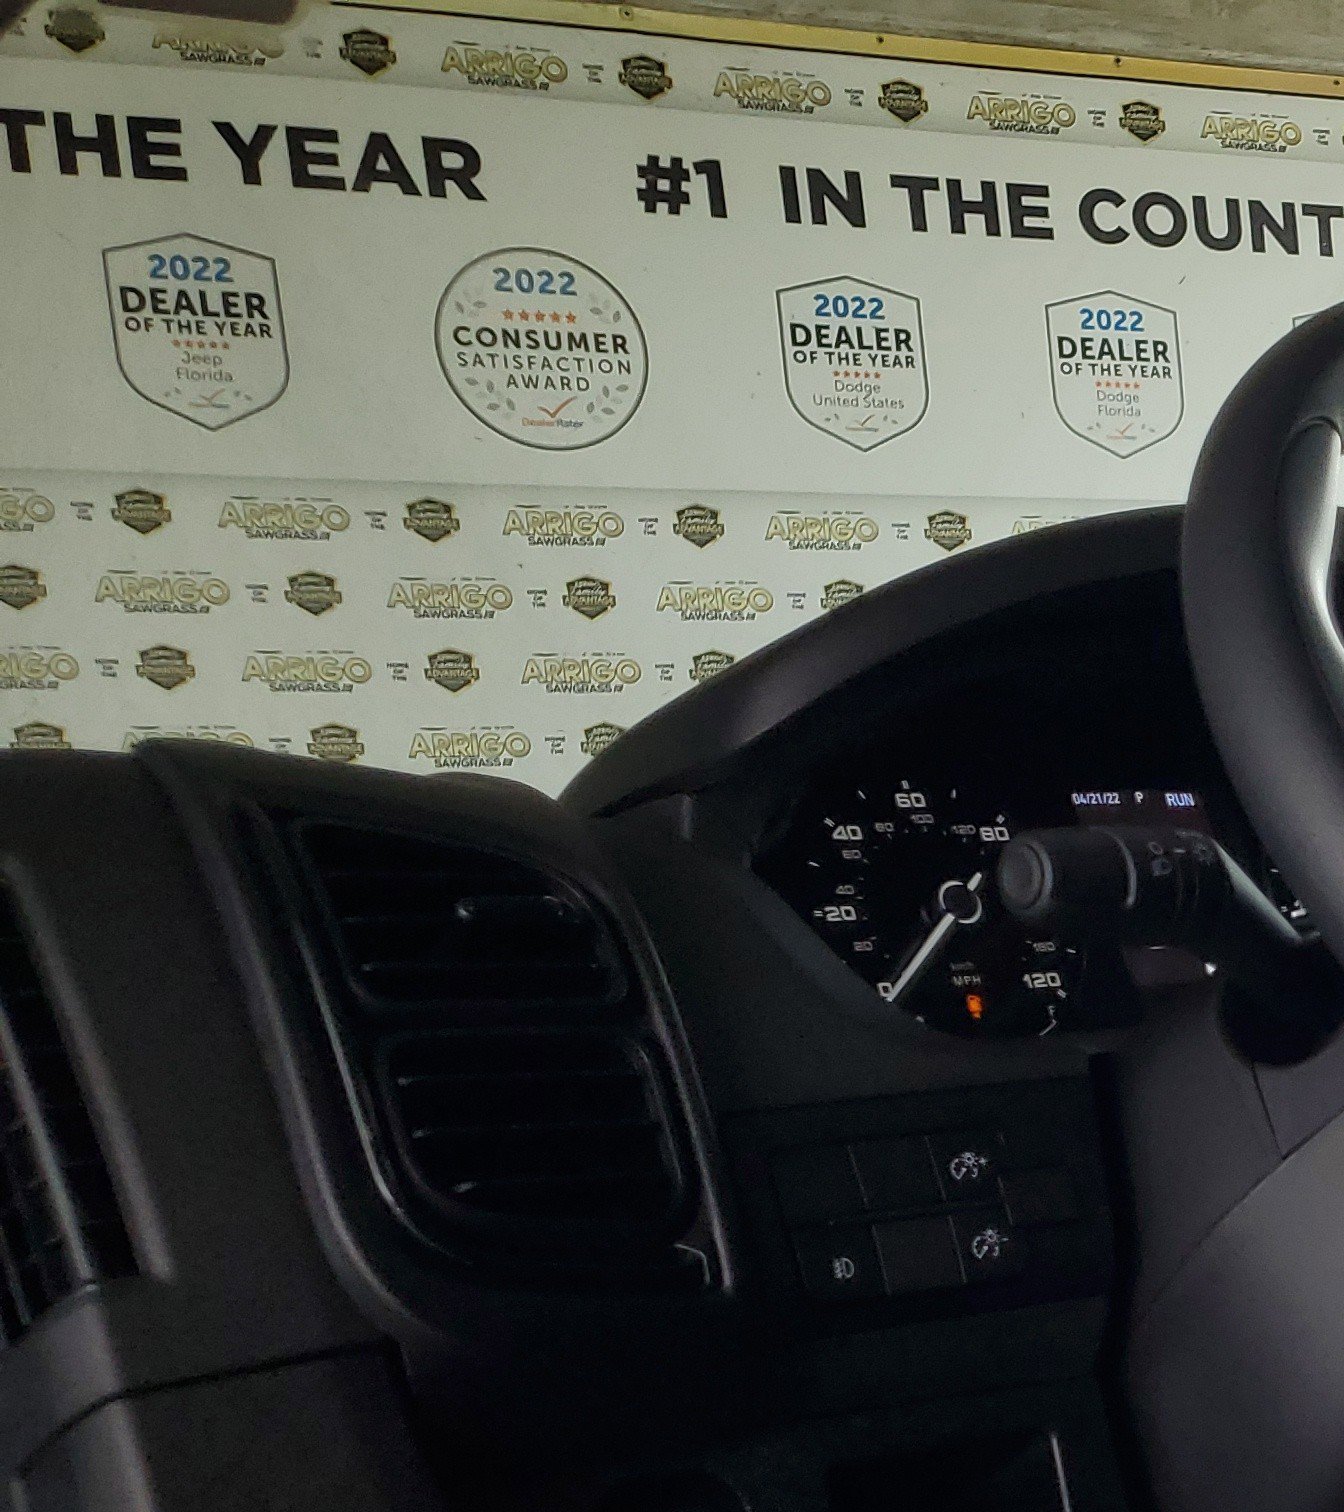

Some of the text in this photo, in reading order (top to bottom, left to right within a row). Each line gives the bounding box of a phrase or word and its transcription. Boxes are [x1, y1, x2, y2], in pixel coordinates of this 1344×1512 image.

[441, 46, 568, 83] ARRIGO
[713, 72, 832, 106] ARRIGO
[967, 95, 1076, 128] ARRIGO
[1200, 116, 1302, 147] ARRIGO
[0, 108, 487, 201] THE YEAR
[636, 154, 728, 219] #1
[779, 165, 866, 228] IN
[889, 174, 1054, 240] THE
[148, 254, 234, 282] 2022
[493, 267, 577, 296] 2022
[119, 285, 270, 320] DEALER
[813, 293, 886, 320] 2022
[125, 316, 273, 338] OF THE YEAR
[1079, 308, 1145, 332] 2022
[453, 326, 630, 355] CONSUMER
[789, 322, 914, 352] DEALER
[1057, 335, 1171, 363] DEALER
[181, 351, 223, 366] Jeep
[456, 351, 632, 375] SATISFACTION
[793, 350, 916, 369] OF THE YEAR
[1060, 362, 1173, 379] OF THE YEAR
[175, 366, 234, 382] Florida
[506, 374, 590, 391] AWARD
[813, 394, 905, 409] United States
[834, 380, 881, 397] Dodge
[1096, 390, 1140, 405] Dodge
[1097, 404, 1141, 417] Florida
[219, 502, 350, 531] ARRIGO
[502, 510, 625, 538] ARRIGO
[765, 516, 879, 542] ARRIGO
[95, 576, 230, 606] ARRIGO
[387, 583, 513, 610] ARRIGO
[656, 587, 774, 612] ARRIGO
[242, 655, 373, 684] ARRIGO
[521, 658, 642, 685] ARRIGO
[409, 732, 531, 758] ARRIGO
[894, 792, 927, 808] 60
[1070, 791, 1195, 808] 04/21/22 P RUN
[831, 825, 864, 841] 40
[978, 826, 1011, 842] 80
[823, 905, 858, 922] 20
[876, 981, 893, 998] 0
[1021, 971, 1062, 989] 120
